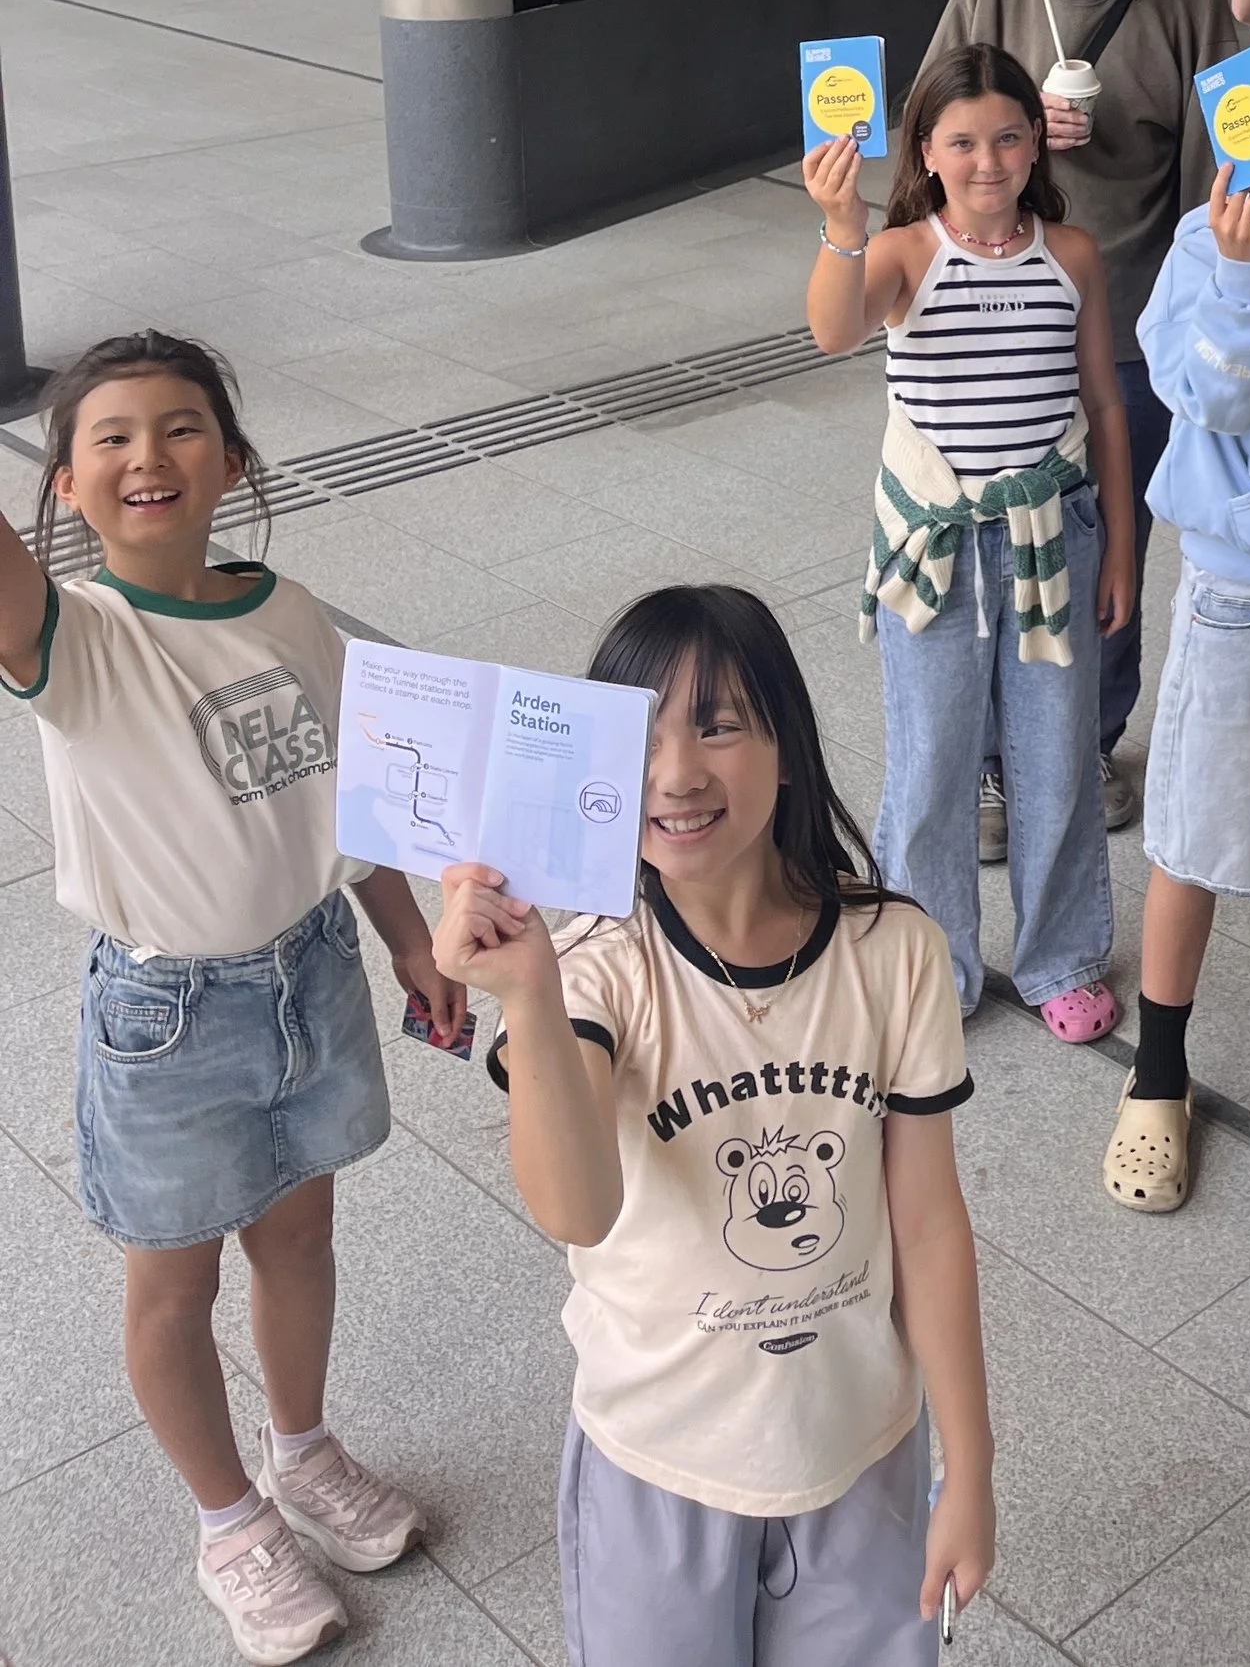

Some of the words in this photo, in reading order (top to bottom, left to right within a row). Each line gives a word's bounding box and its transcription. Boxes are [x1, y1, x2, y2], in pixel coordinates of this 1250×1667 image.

[816, 92, 867, 106] Passport
[979, 301, 1025, 314] ROAD
[361, 660, 383, 672] Make
[383, 666, 401, 676] your
[402, 670, 418, 680] way
[419, 672, 452, 686] through
[452, 678, 468, 688] the
[367, 671, 391, 684] Metro
[393, 675, 419, 690] Tunnel
[419, 683, 452, 696] stations
[453, 688, 470, 699] and
[359, 681, 387, 693] collect
[394, 688, 420, 701] stamp
[420, 694, 429, 702] at
[430, 696, 451, 707] each
[451, 700, 473, 711] stop.
[512, 690, 561, 715] Arden
[510, 709, 571, 736] Station
[224, 722, 338, 791] CLASSI
[688, 1291, 719, 1316] I
[769, 1259, 870, 1314] understand
[697, 1319, 716, 1333] CAN
[718, 1321, 741, 1332] YOU
[743, 1319, 788, 1331] EXPLAIN
[790, 1316, 799, 1327] IT
[801, 1312, 812, 1323] IN
[813, 1302, 840, 1320] MORE
[841, 1288, 871, 1308] DETAIL
[763, 1333, 816, 1351] Confusion
